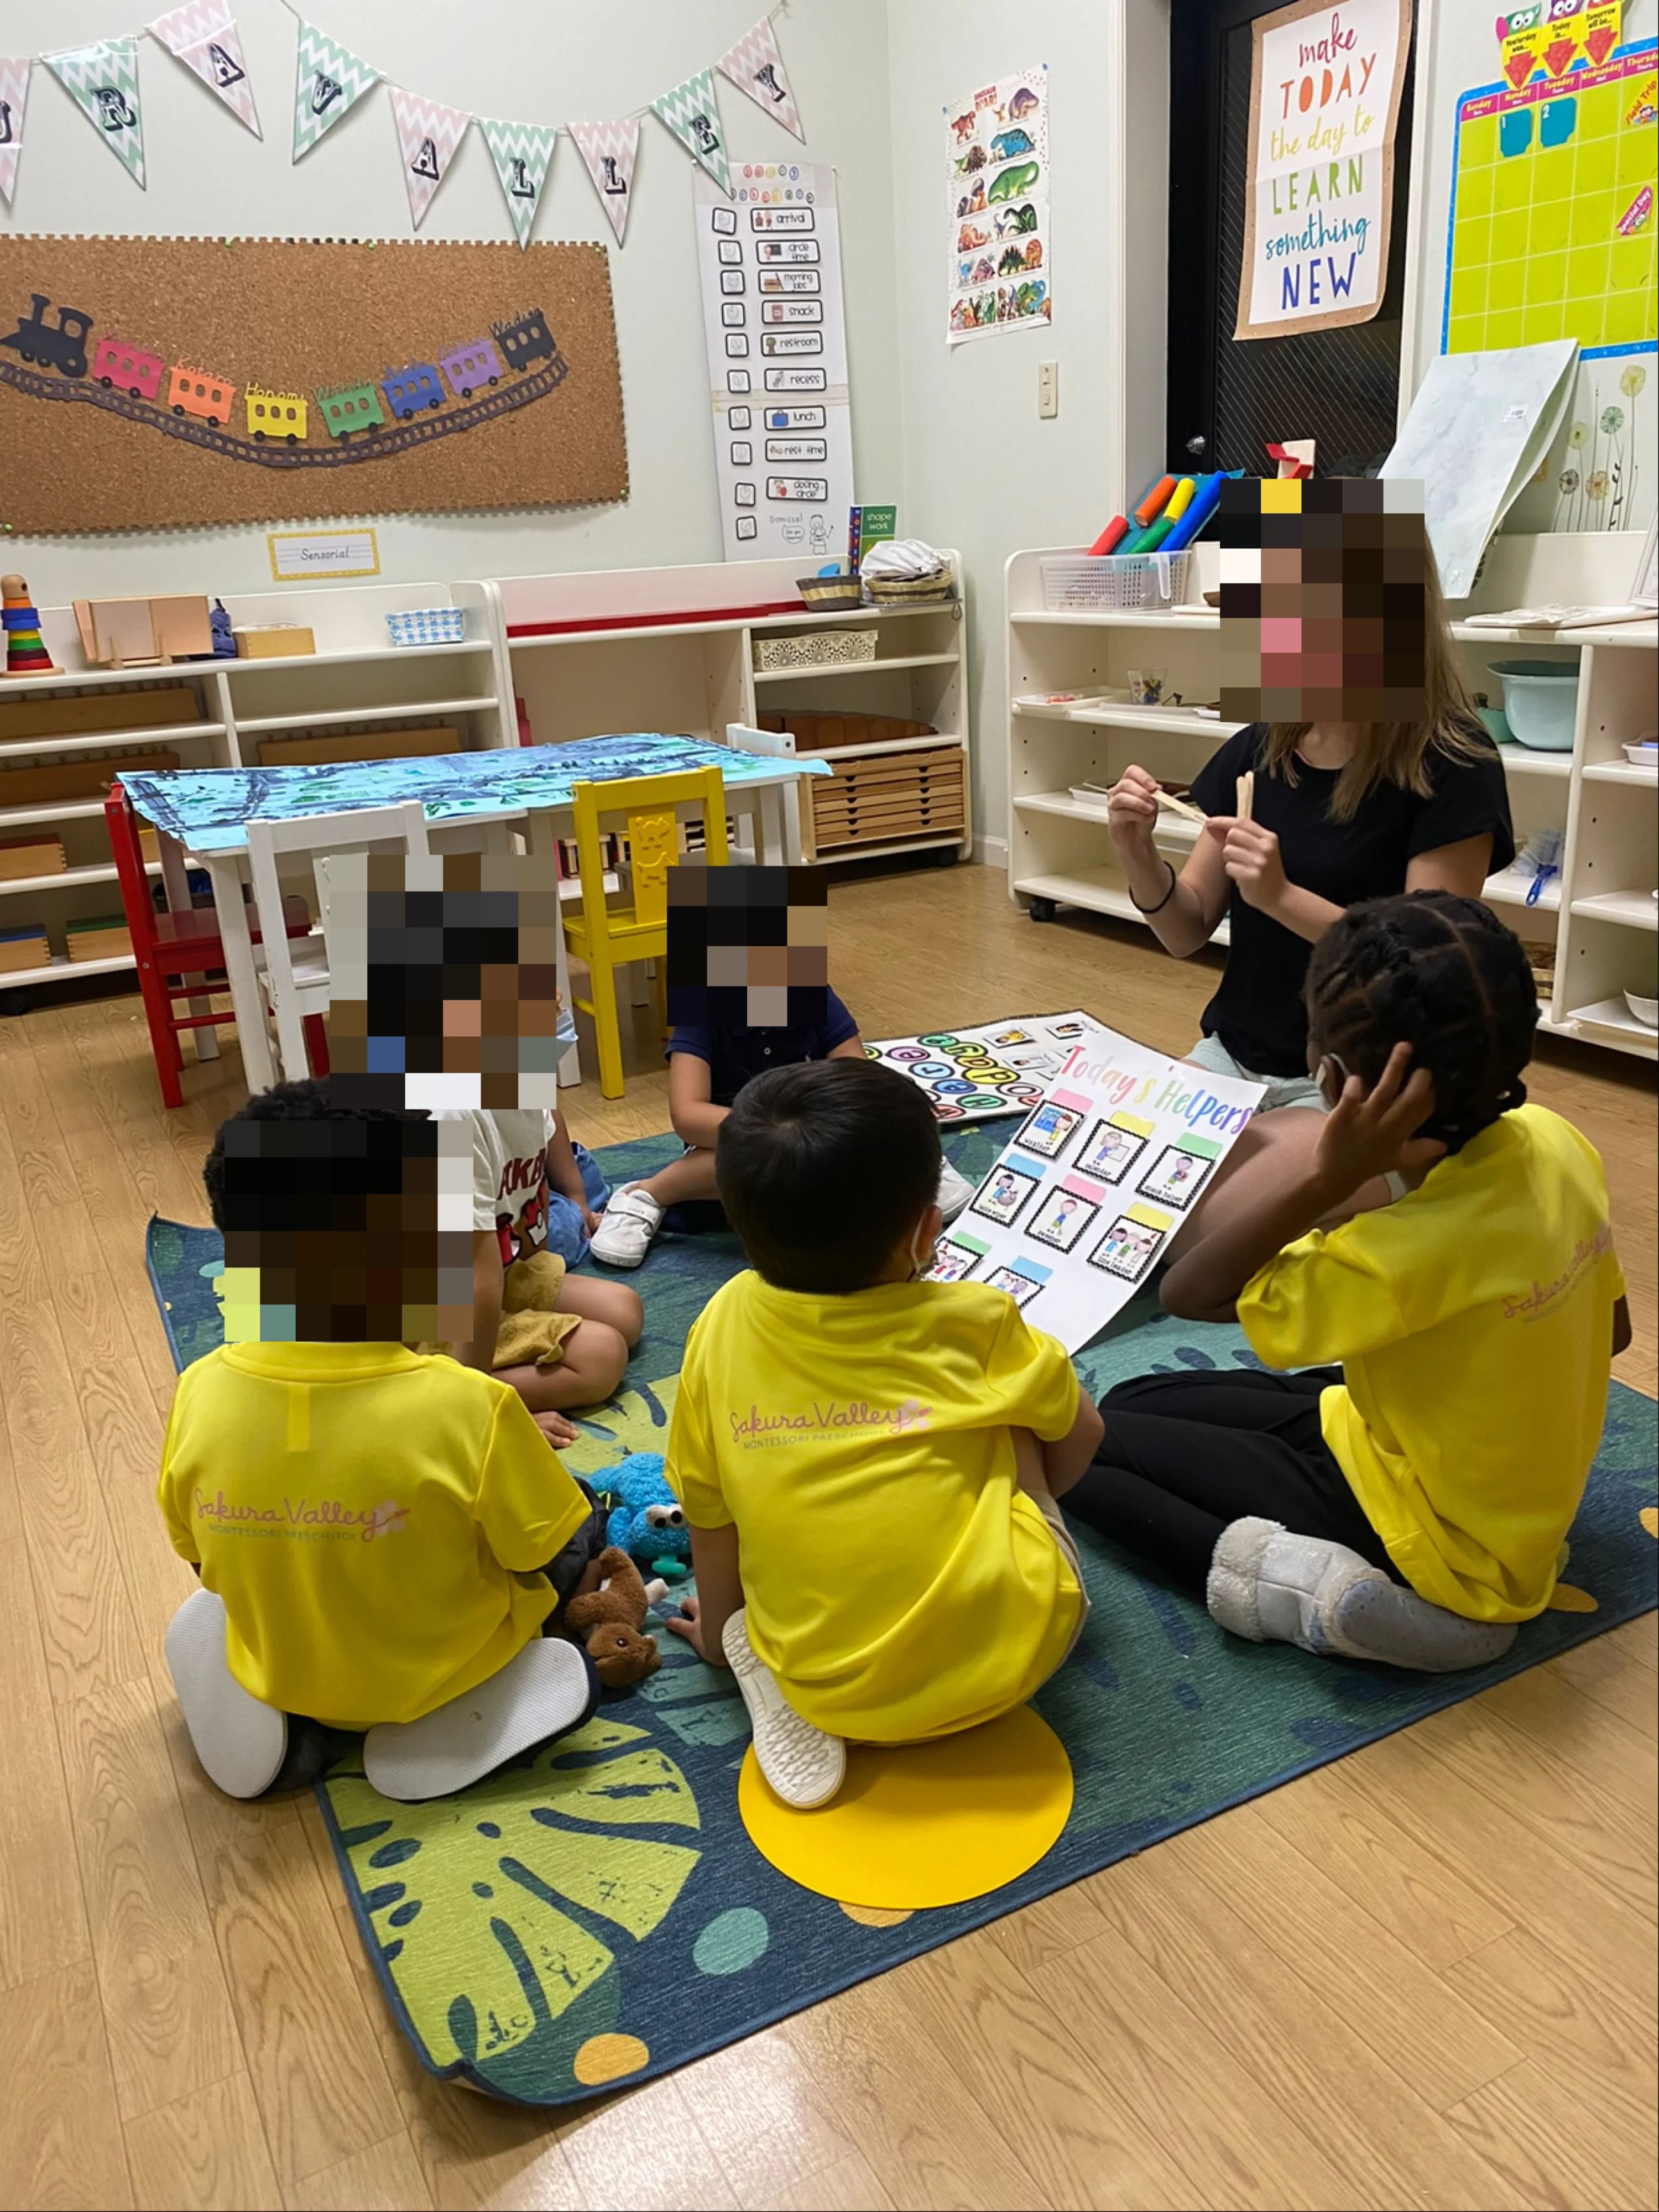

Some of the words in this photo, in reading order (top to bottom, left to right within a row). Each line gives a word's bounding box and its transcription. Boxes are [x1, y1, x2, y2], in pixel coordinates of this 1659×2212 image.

[1300, 12, 1358, 67] make
[1280, 53, 1377, 119] TODAY
[1641, 80, 1657, 100] Trip
[1542, 105, 1550, 118] 2
[1501, 116, 1506, 129] 1
[1270, 126, 1300, 161] the
[1307, 116, 1346, 155] day
[1354, 103, 1375, 138] to
[1272, 154, 1363, 215] LEARN
[776, 213, 806, 224] arrival
[1266, 210, 1371, 260] something
[789, 243, 809, 252] circle
[784, 274, 813, 283] morning
[1281, 252, 1357, 310] NEW
[789, 305, 815, 316] snack
[780, 337, 818, 348] restroom
[790, 374, 821, 385] recess
[794, 411, 816, 421] lunch
[784, 446, 802, 455] rest
[867, 513, 892, 521] shape
[869, 521, 889, 530] work
[300, 546, 349, 561] Sensorial
[1061, 1045, 1157, 1105] Today's
[1154, 1080, 1253, 1134] Helpers
[729, 1405, 815, 1442] Sakura
[813, 1402, 915, 1434] Valley
[744, 1436, 808, 1451] MONTESSORI
[194, 1488, 284, 1522] Sakura
[284, 1496, 394, 1543] Valley
